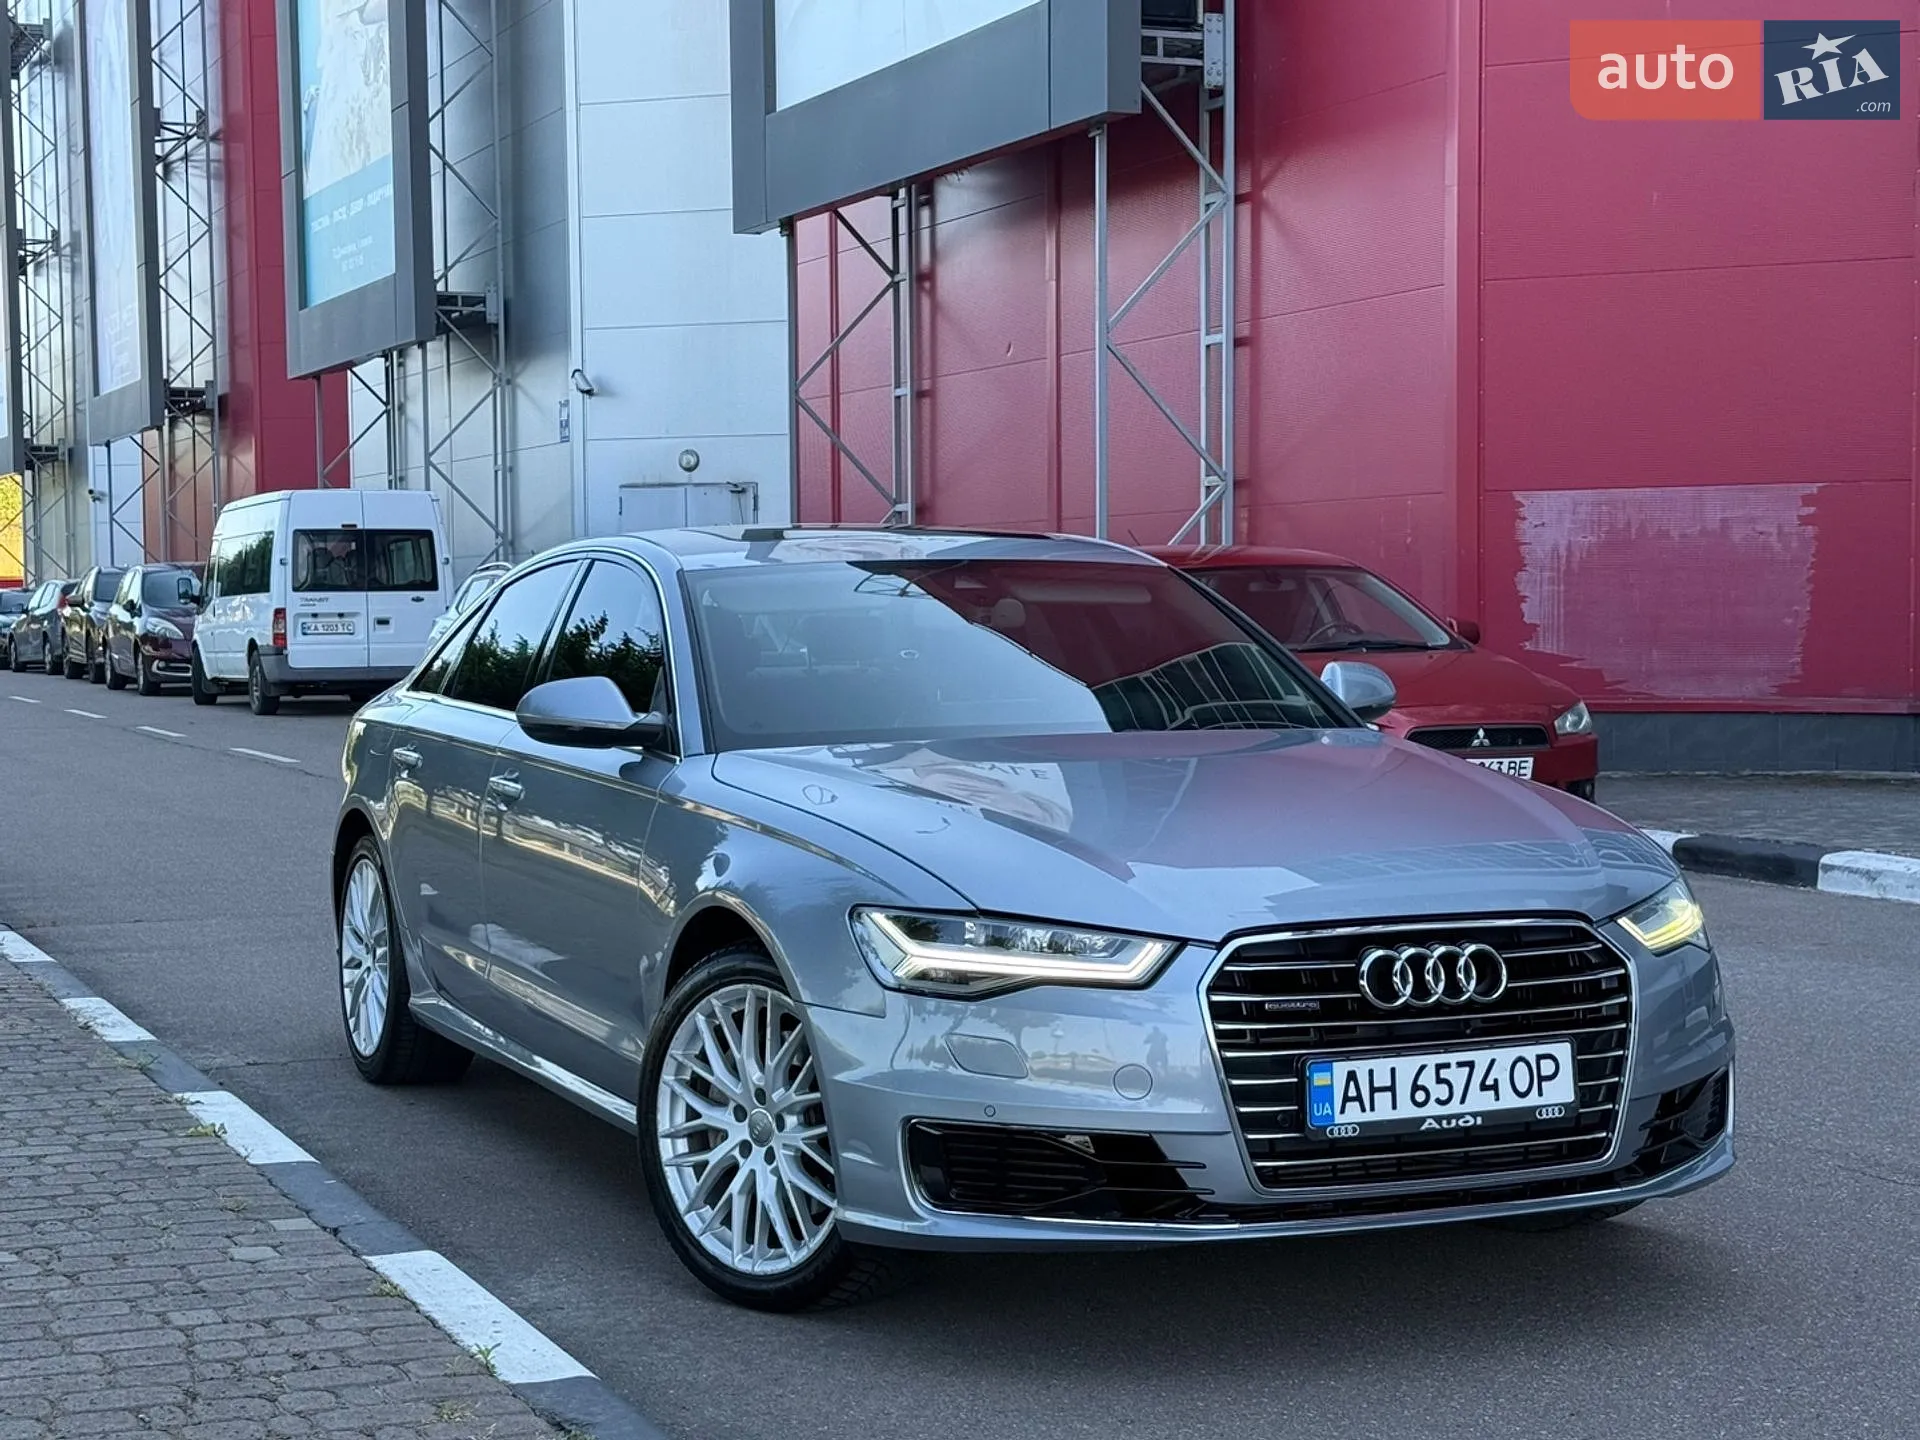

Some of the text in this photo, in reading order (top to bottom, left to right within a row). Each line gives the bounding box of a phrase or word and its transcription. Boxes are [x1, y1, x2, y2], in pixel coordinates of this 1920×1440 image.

[1339, 1053, 1560, 1115] AH 6574 OP
[1313, 1102, 1332, 1117] UA
[1419, 1115, 1482, 1131] Audi
